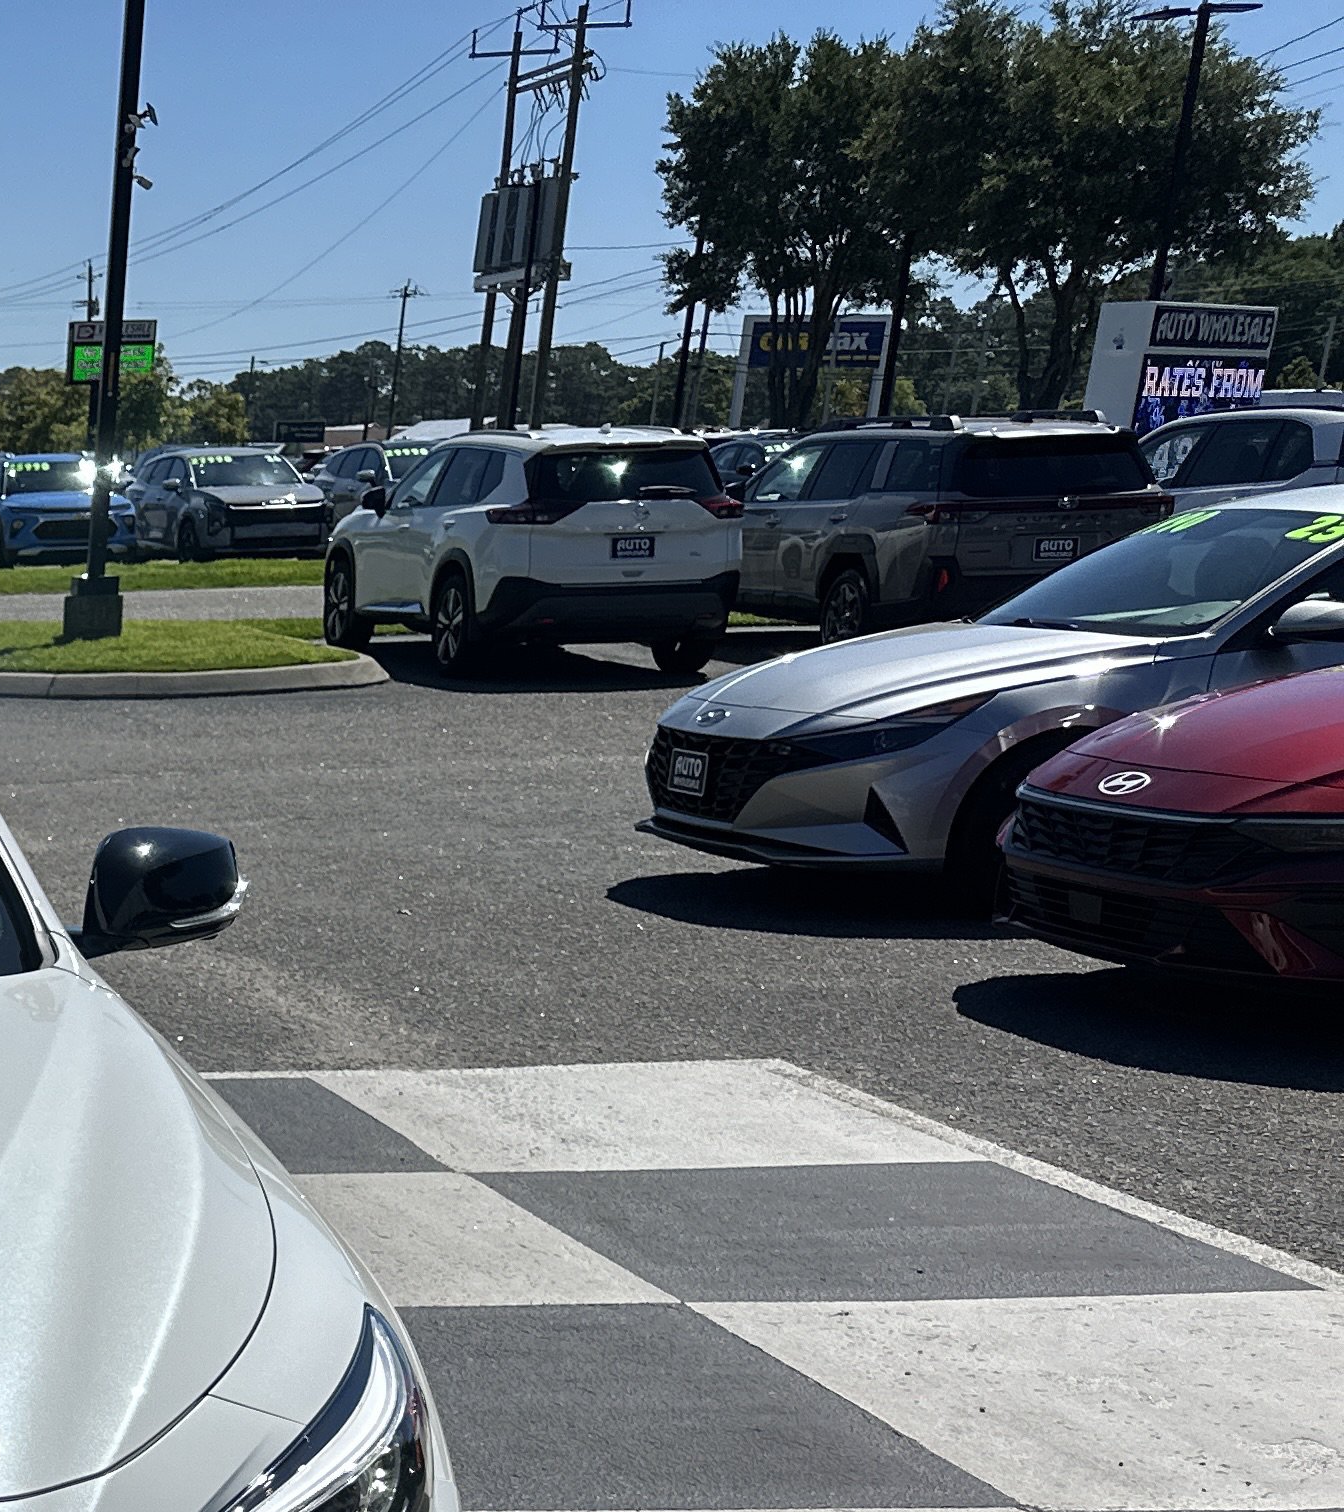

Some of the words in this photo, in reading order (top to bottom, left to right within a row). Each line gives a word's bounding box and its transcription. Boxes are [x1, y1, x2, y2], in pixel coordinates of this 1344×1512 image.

[1156, 312, 1196, 342] AUTO
[1198, 314, 1273, 344] WHOLESALE
[1142, 366, 1206, 397] RATES
[1209, 368, 1265, 398] FROM
[617, 539, 650, 550] AUTO
[1040, 540, 1074, 551] AUTO
[675, 755, 702, 778] AUTO
